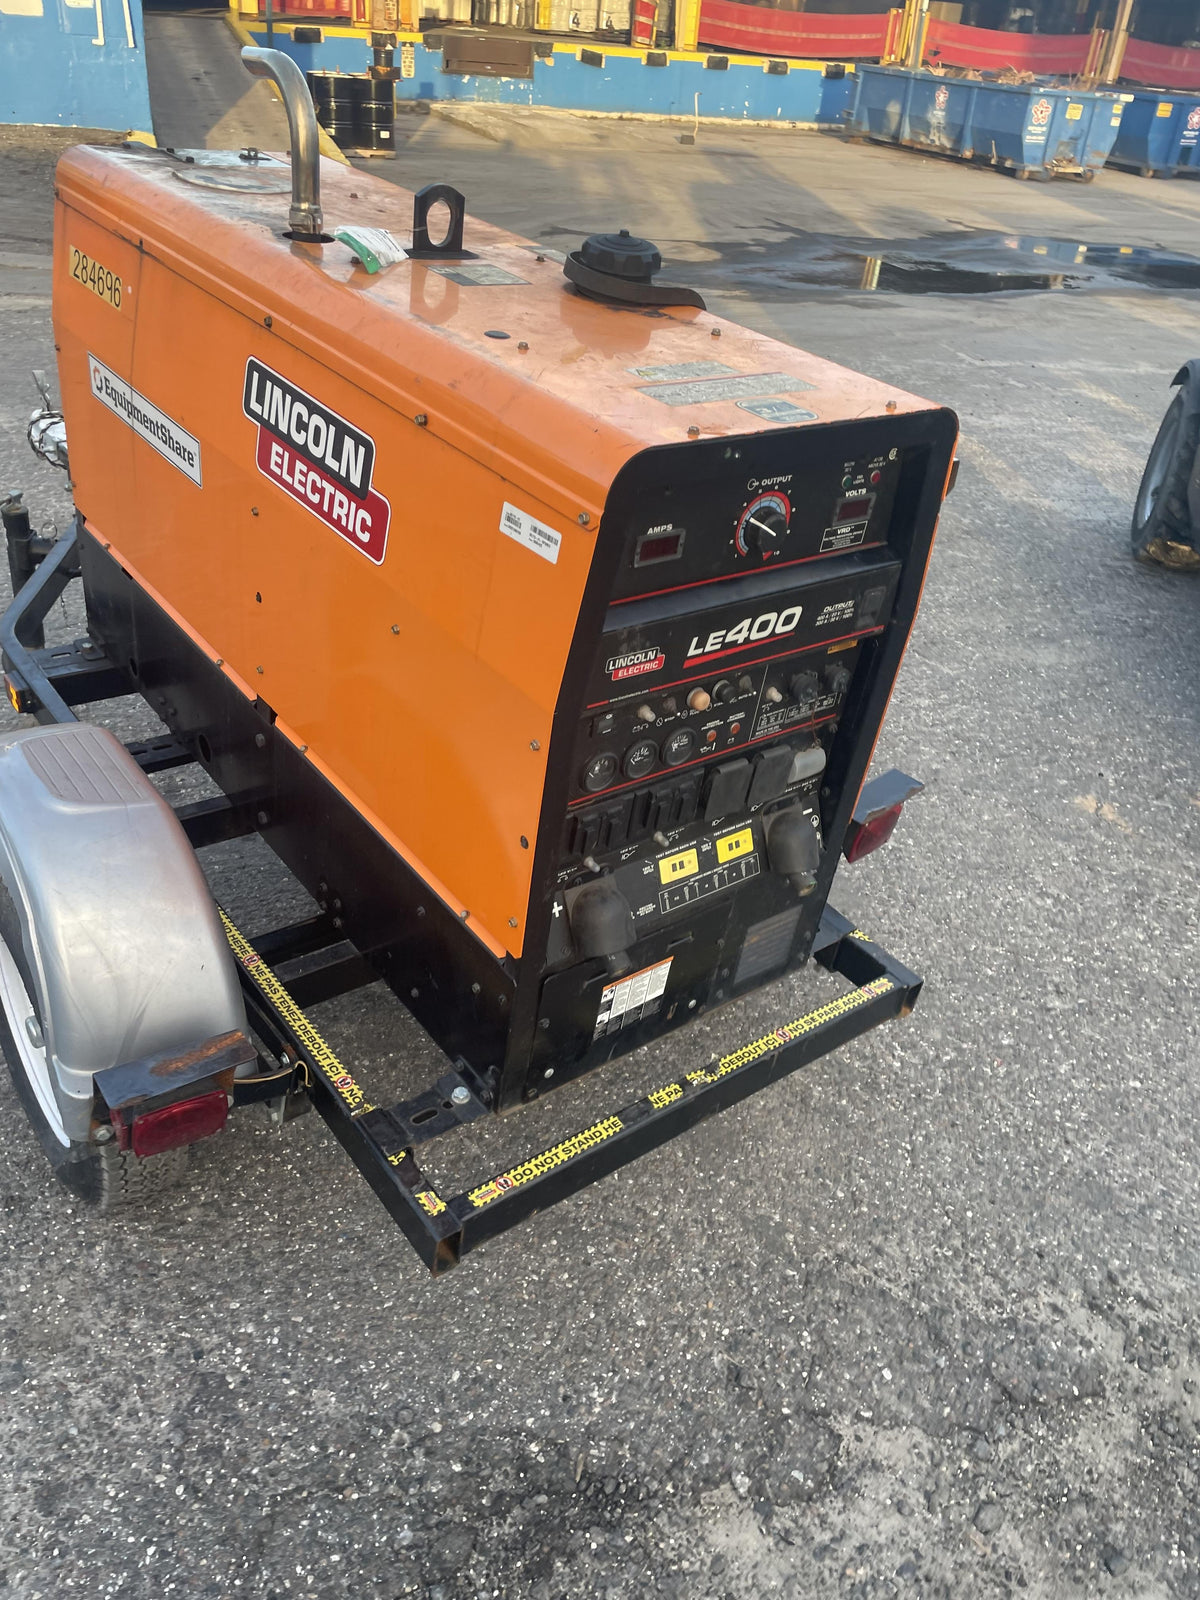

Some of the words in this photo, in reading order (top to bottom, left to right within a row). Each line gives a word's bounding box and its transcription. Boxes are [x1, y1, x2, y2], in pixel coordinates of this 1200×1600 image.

[73, 249, 122, 308] 284696
[103, 377, 195, 468] EquipmentShare
[249, 370, 366, 489] LINCOLN
[269, 441, 372, 543] ELECTRIC
[761, 474, 793, 486] OUTPUT
[845, 488, 867, 497] VOLTS
[647, 523, 673, 535] AMPS
[687, 606, 803, 657] LE400
[609, 649, 657, 670] LINCOLN
[618, 661, 659, 677] ELECTRIC
[229, 933, 250, 956] HERE
[253, 964, 266, 979] NE
[263, 978, 280, 995] PAS
[277, 994, 301, 1024] TENEZ
[297, 1023, 331, 1061] DEBOUT
[327, 1062, 341, 1076] ICI
[788, 1023, 804, 1034] NO
[804, 1017, 819, 1026] SE
[817, 1003, 842, 1019] PARE
[721, 1044, 763, 1069] DEBOUT
[763, 1037, 778, 1048] ICI
[513, 1168, 533, 1181] DO
[534, 1151, 561, 1170] NOT
[562, 1130, 602, 1155] STAND
